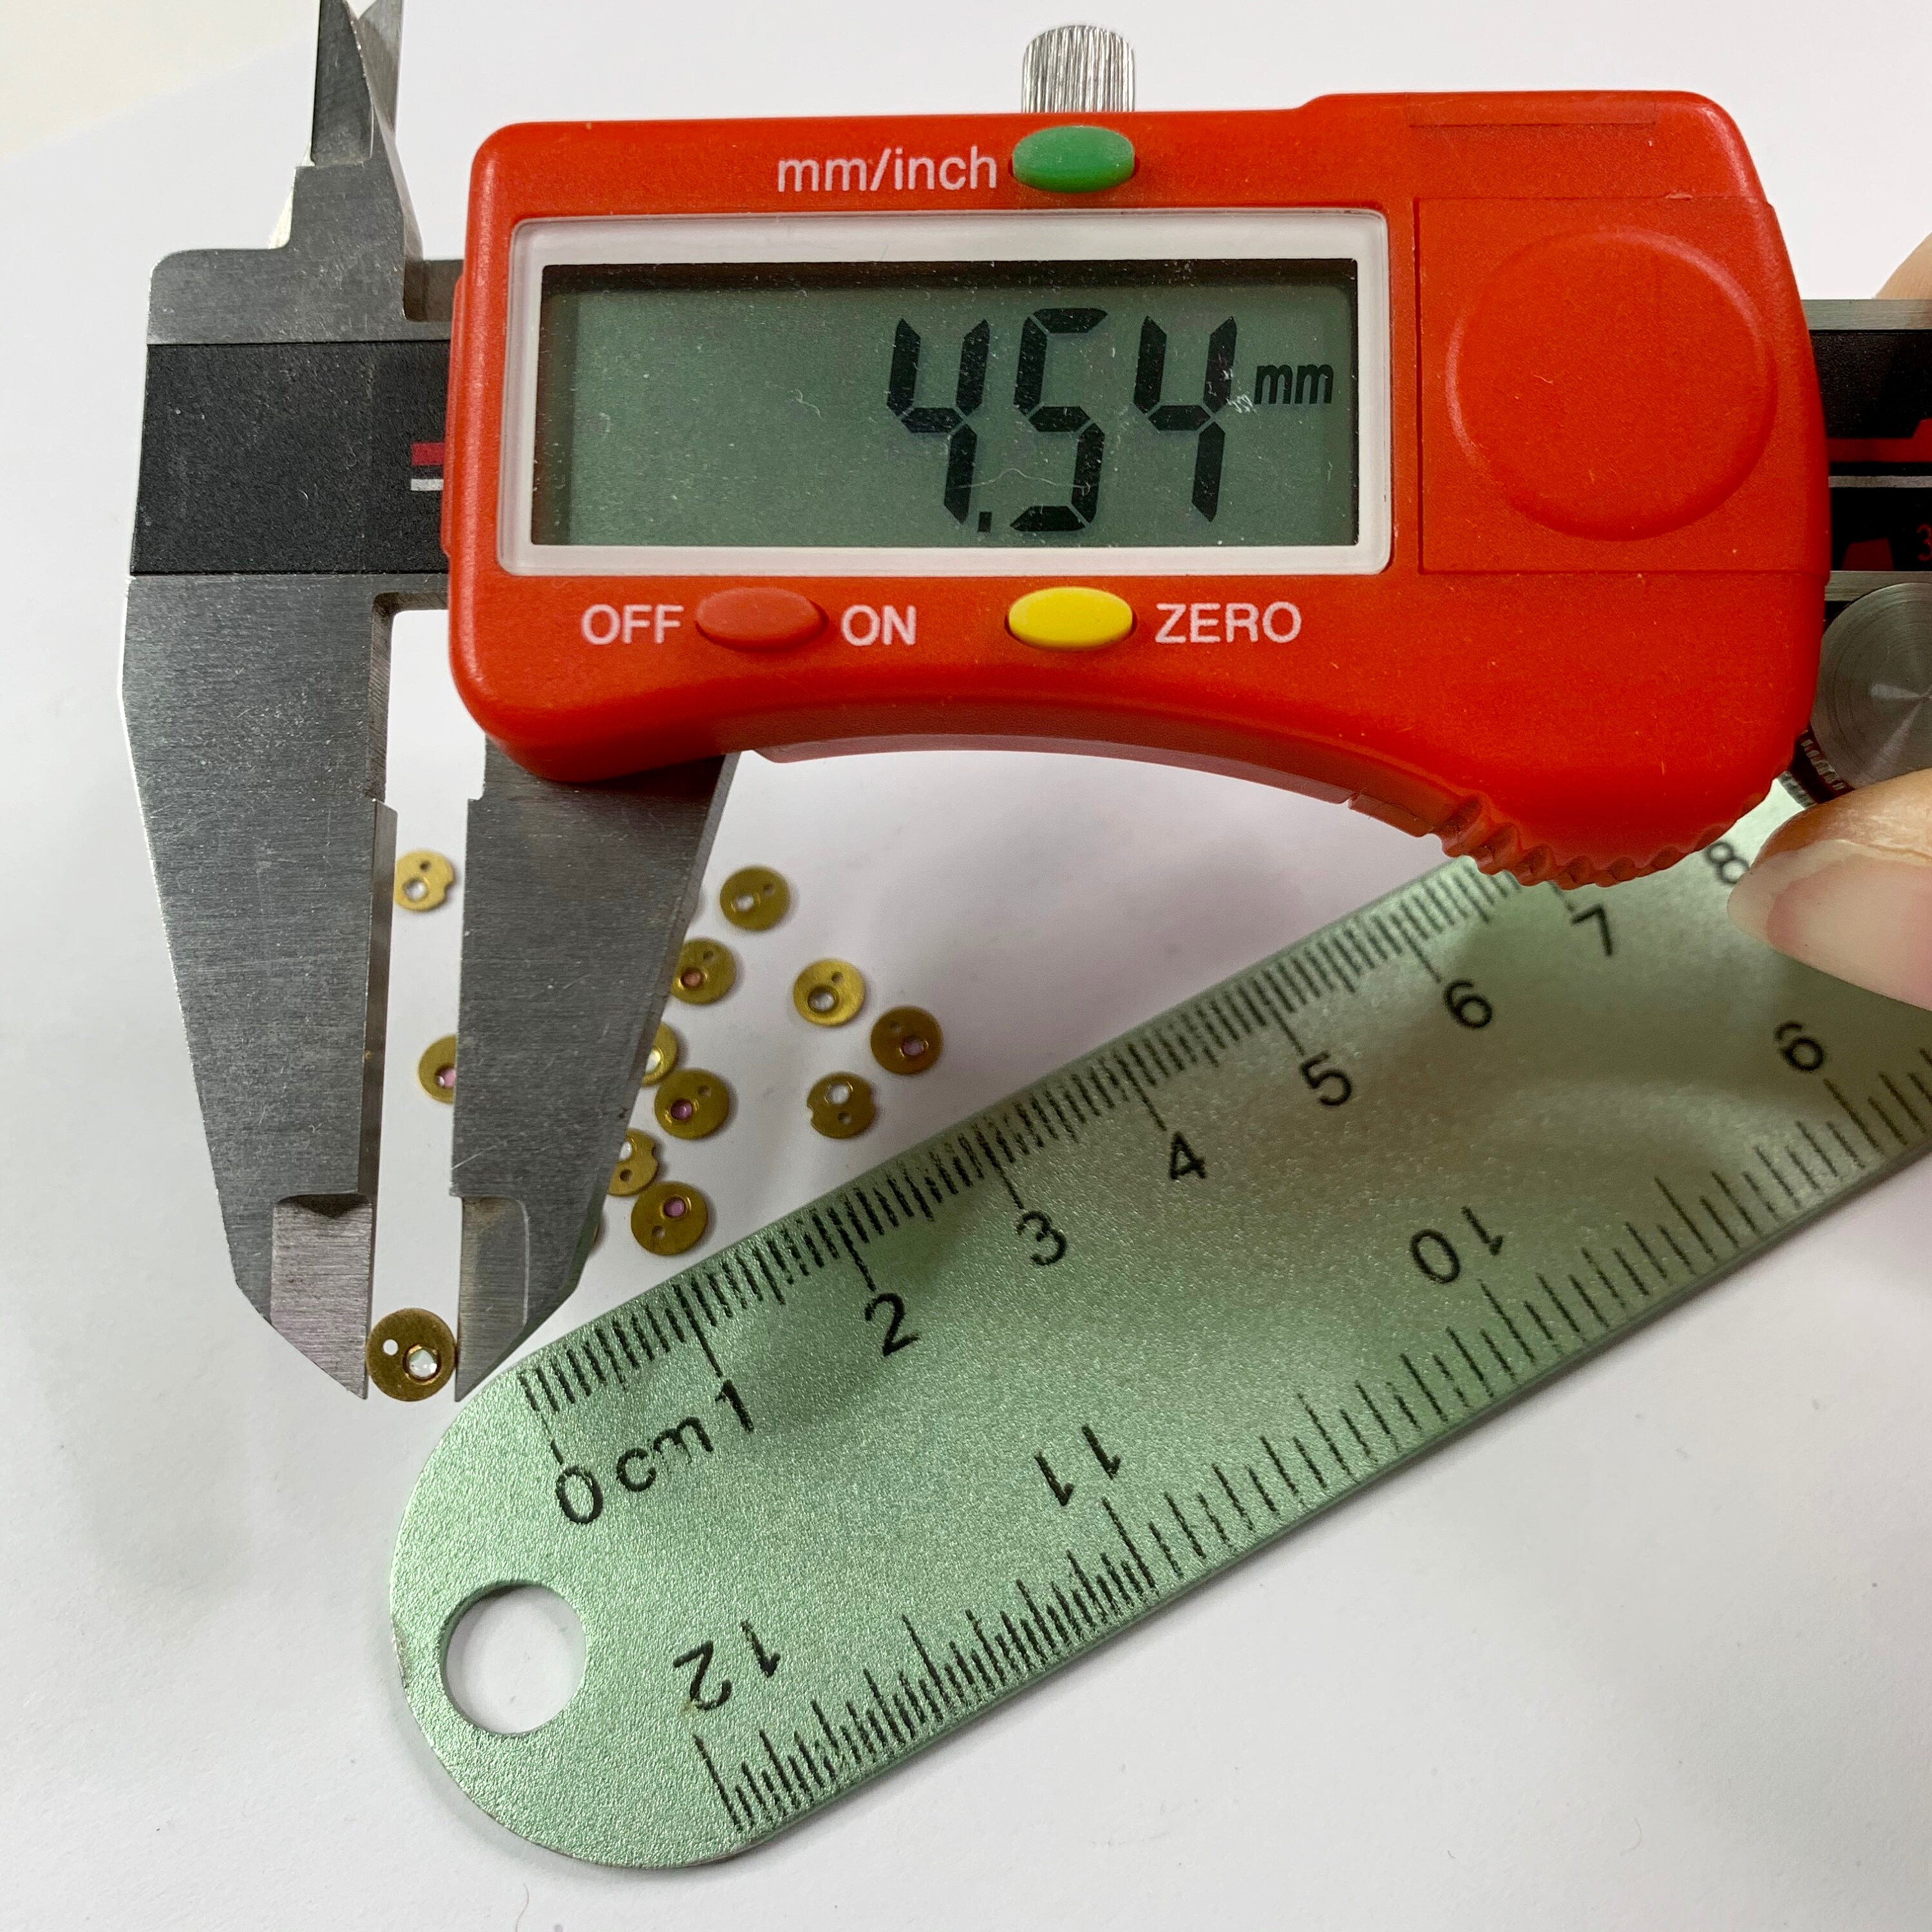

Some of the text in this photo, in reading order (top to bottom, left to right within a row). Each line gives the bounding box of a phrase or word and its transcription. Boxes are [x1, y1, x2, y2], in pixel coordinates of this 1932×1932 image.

[777, 146, 997, 193] mm/inch
[886, 307, 1334, 533] 4.54 mm
[581, 603, 685, 645] OFF
[840, 604, 917, 646] ON
[1154, 600, 1302, 645] ZERO
[616, 1416, 714, 1493] cm
[715, 1379, 754, 1434] 1
[865, 1291, 921, 1358] 2
[1016, 1209, 1067, 1266] 3
[1168, 1131, 1206, 1180] 4
[1300, 1051, 1353, 1106] 5
[1443, 979, 1494, 1029] 6
[1571, 904, 1616, 957] 7
[1705, 840, 1752, 886] 8
[1410, 1206, 1503, 1284] 10
[1034, 1425, 1121, 1506] 11
[674, 1620, 781, 1711] 12
